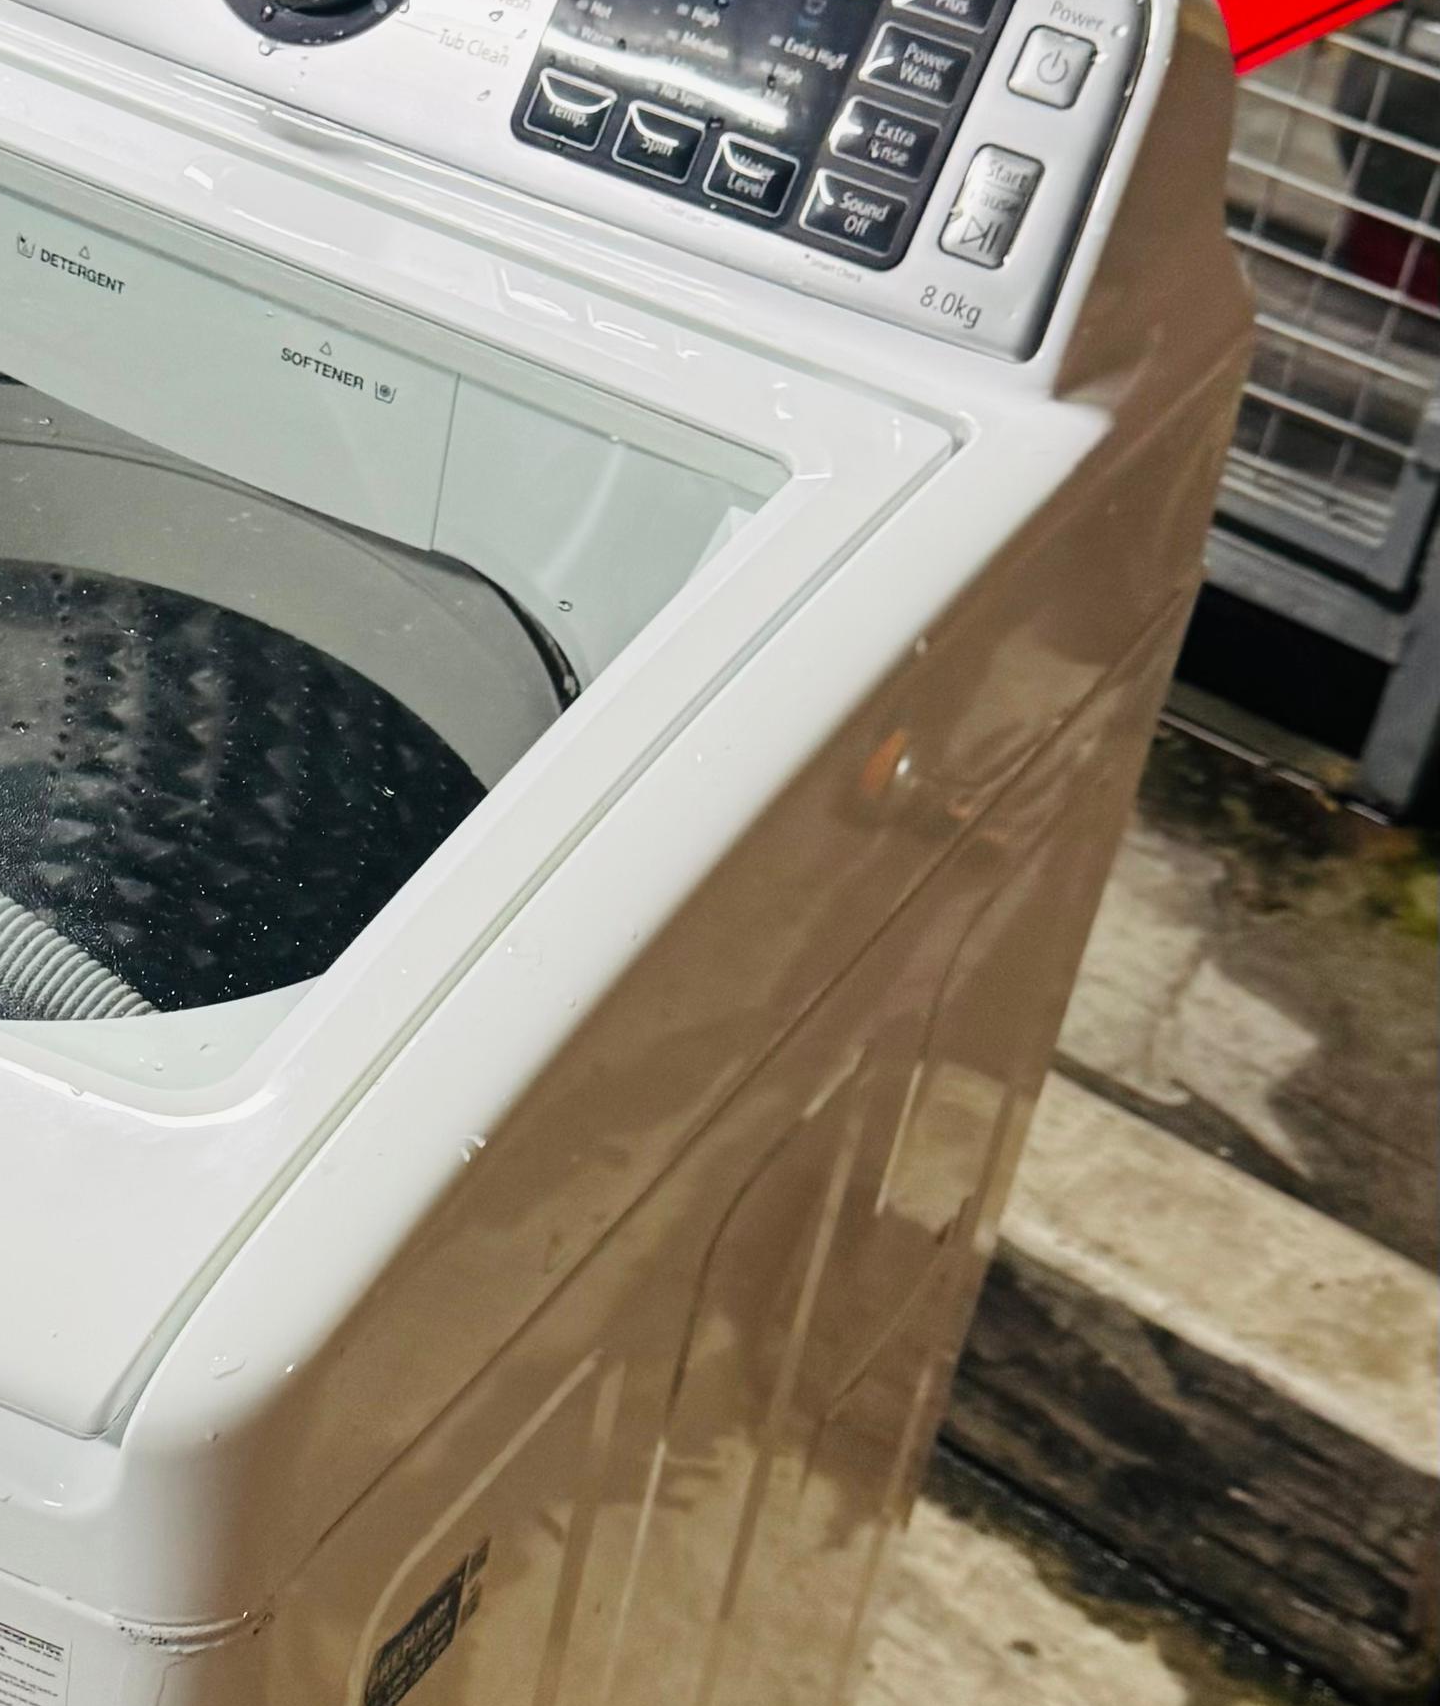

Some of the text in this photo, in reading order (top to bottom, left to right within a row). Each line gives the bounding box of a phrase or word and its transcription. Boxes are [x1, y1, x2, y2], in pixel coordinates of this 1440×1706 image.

[439, 28, 510, 67] Tub Clean
[904, 42, 955, 71] Power
[899, 63, 944, 92] Wash
[873, 118, 918, 147] Extra
[869, 137, 911, 168] nse
[727, 171, 769, 198] Level
[985, 157, 1030, 188] Start
[840, 192, 890, 223] Sound
[972, 190, 1022, 216] ause
[843, 215, 872, 238] Off
[40, 248, 126, 294] DETERGENT
[919, 284, 983, 330] 8.0kg
[280, 346, 365, 392] SOFTENER
